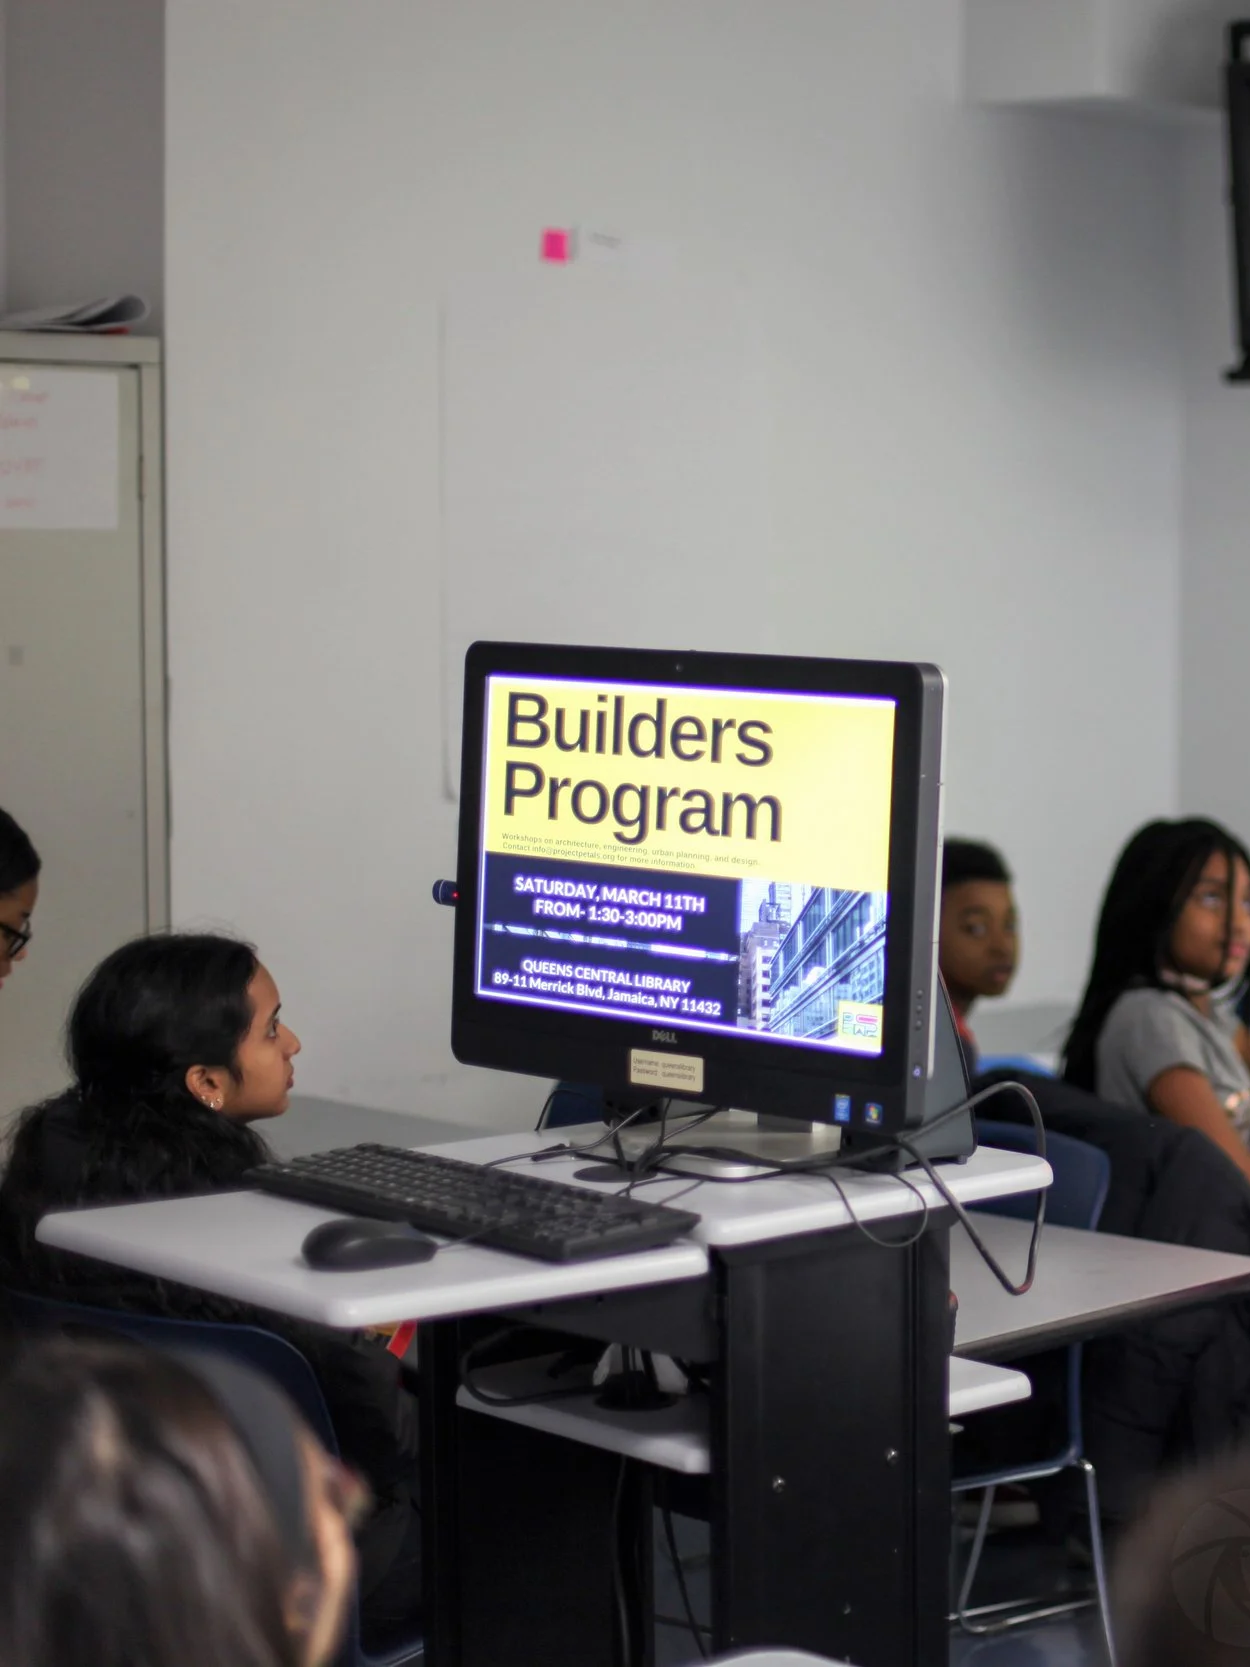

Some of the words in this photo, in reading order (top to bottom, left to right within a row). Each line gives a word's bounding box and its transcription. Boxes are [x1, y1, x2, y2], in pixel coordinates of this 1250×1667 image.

[506, 691, 774, 767] Builders
[504, 760, 783, 846] Program
[502, 832, 542, 844] Workshops
[544, 837, 554, 846] on
[652, 849, 675, 858] urban
[714, 854, 730, 864] and
[502, 842, 531, 853] Contact
[532, 844, 616, 862] info@projectpetals.org
[617, 853, 628, 863] for
[630, 856, 649, 866] more
[514, 876, 600, 902] SATURDAY,
[602, 886, 661, 908] MARCH
[664, 894, 706, 913] 11TH
[535, 898, 586, 919] FROM-
[588, 906, 682, 931] 1:30-3:00PM
[522, 959, 573, 978] QUEENS
[575, 966, 632, 986] CENTRAL
[635, 974, 691, 993] LIBRARY
[494, 971, 527, 988] 89-11
[529, 976, 574, 995] Merrick
[576, 983, 605, 1001] Blvd,
[608, 988, 658, 1008] Jamaica,
[660, 996, 679, 1010] NY
[681, 998, 722, 1016] 11432
[652, 1029, 677, 1044] DELL
